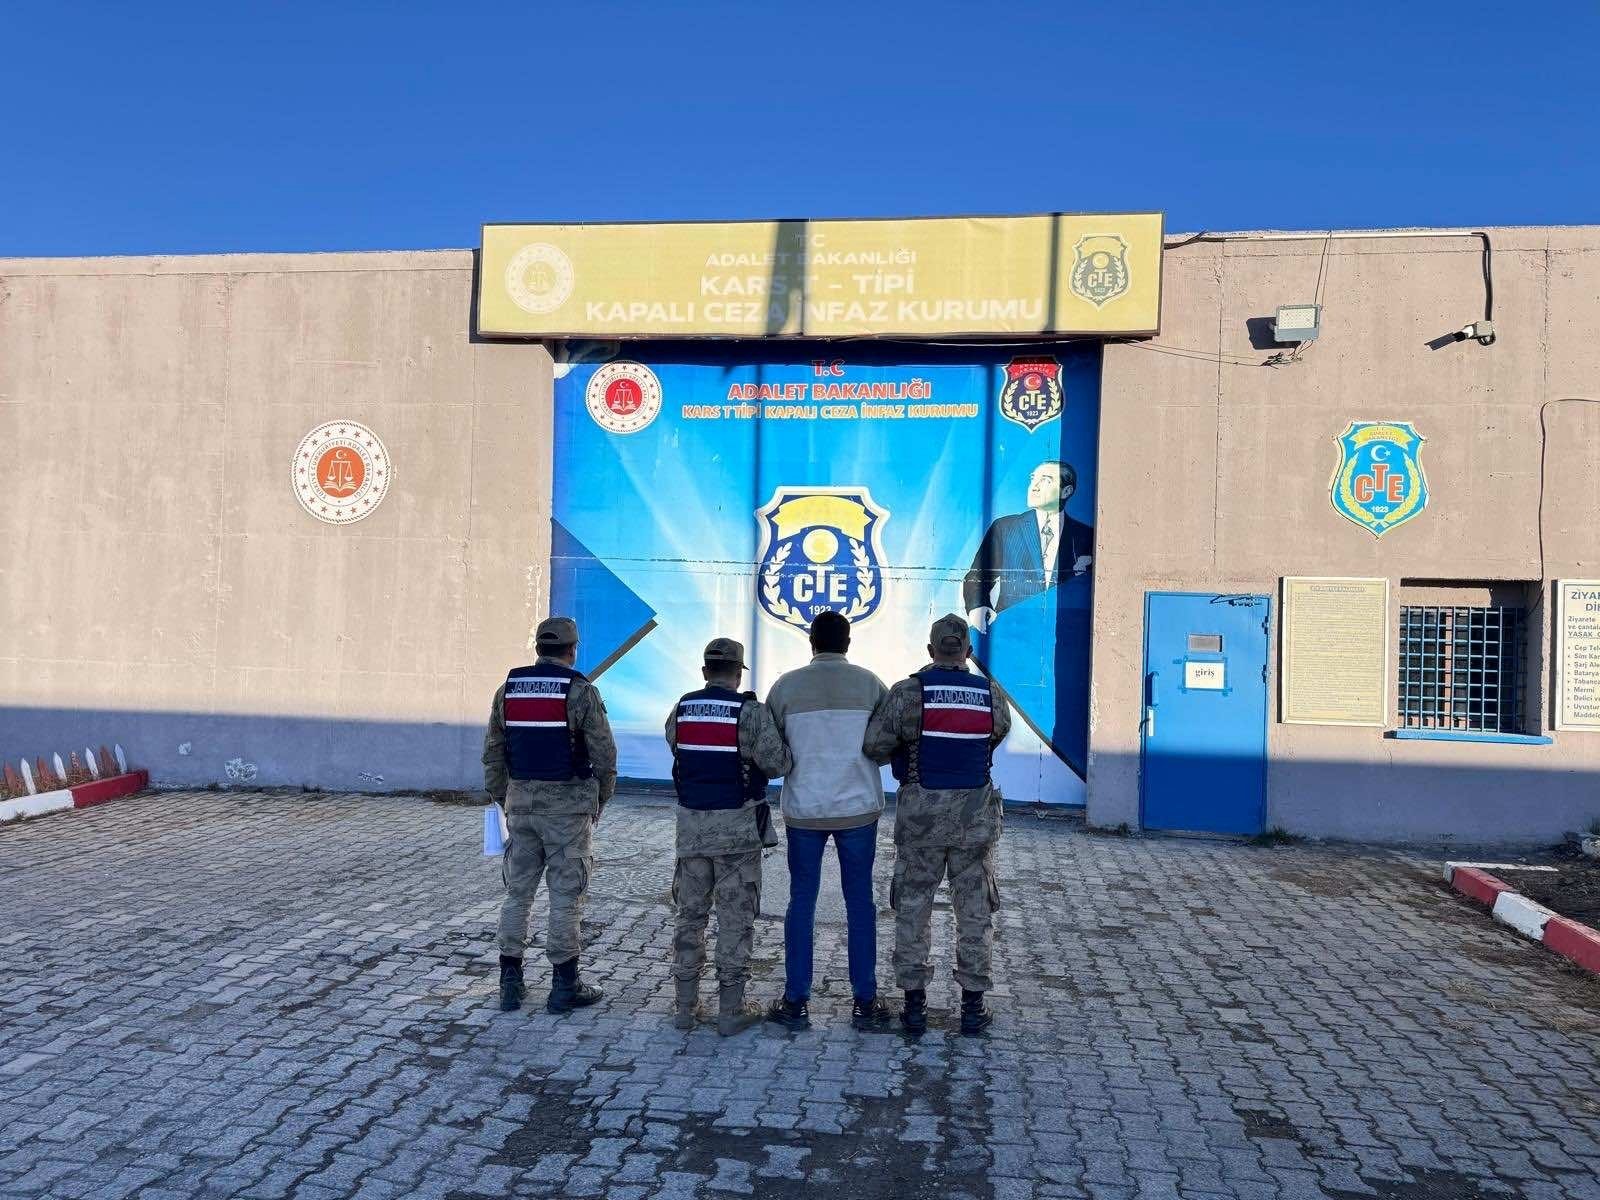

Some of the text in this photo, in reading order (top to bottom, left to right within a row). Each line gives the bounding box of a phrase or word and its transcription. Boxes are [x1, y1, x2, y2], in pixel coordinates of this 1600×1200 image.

[705, 248, 916, 267] ADALET BAKANLIĞI
[701, 275, 788, 296] KARS
[852, 269, 914, 294] TİPİ
[1087, 268, 1113, 287] CTE
[586, 296, 1044, 322] KAPALI CEZA İNFAZ KURUMU
[811, 359, 845, 377] T.C
[726, 378, 931, 400] ADALET BAKANLIĞI
[682, 404, 721, 419] KARS
[733, 401, 761, 419] TİPİ
[765, 405, 817, 419] KAPALI
[820, 405, 858, 419] CEZA
[861, 401, 905, 418] İNFAZ
[907, 403, 978, 418] KURUMU
[1018, 390, 1046, 411] CTE
[1354, 463, 1404, 503] CTE
[793, 564, 847, 602] CTE
[1195, 668, 1215, 678] giriş
[511, 681, 561, 695] JANDARMA
[930, 689, 986, 706] JANDARMA
[683, 703, 731, 718] JANDARMA
